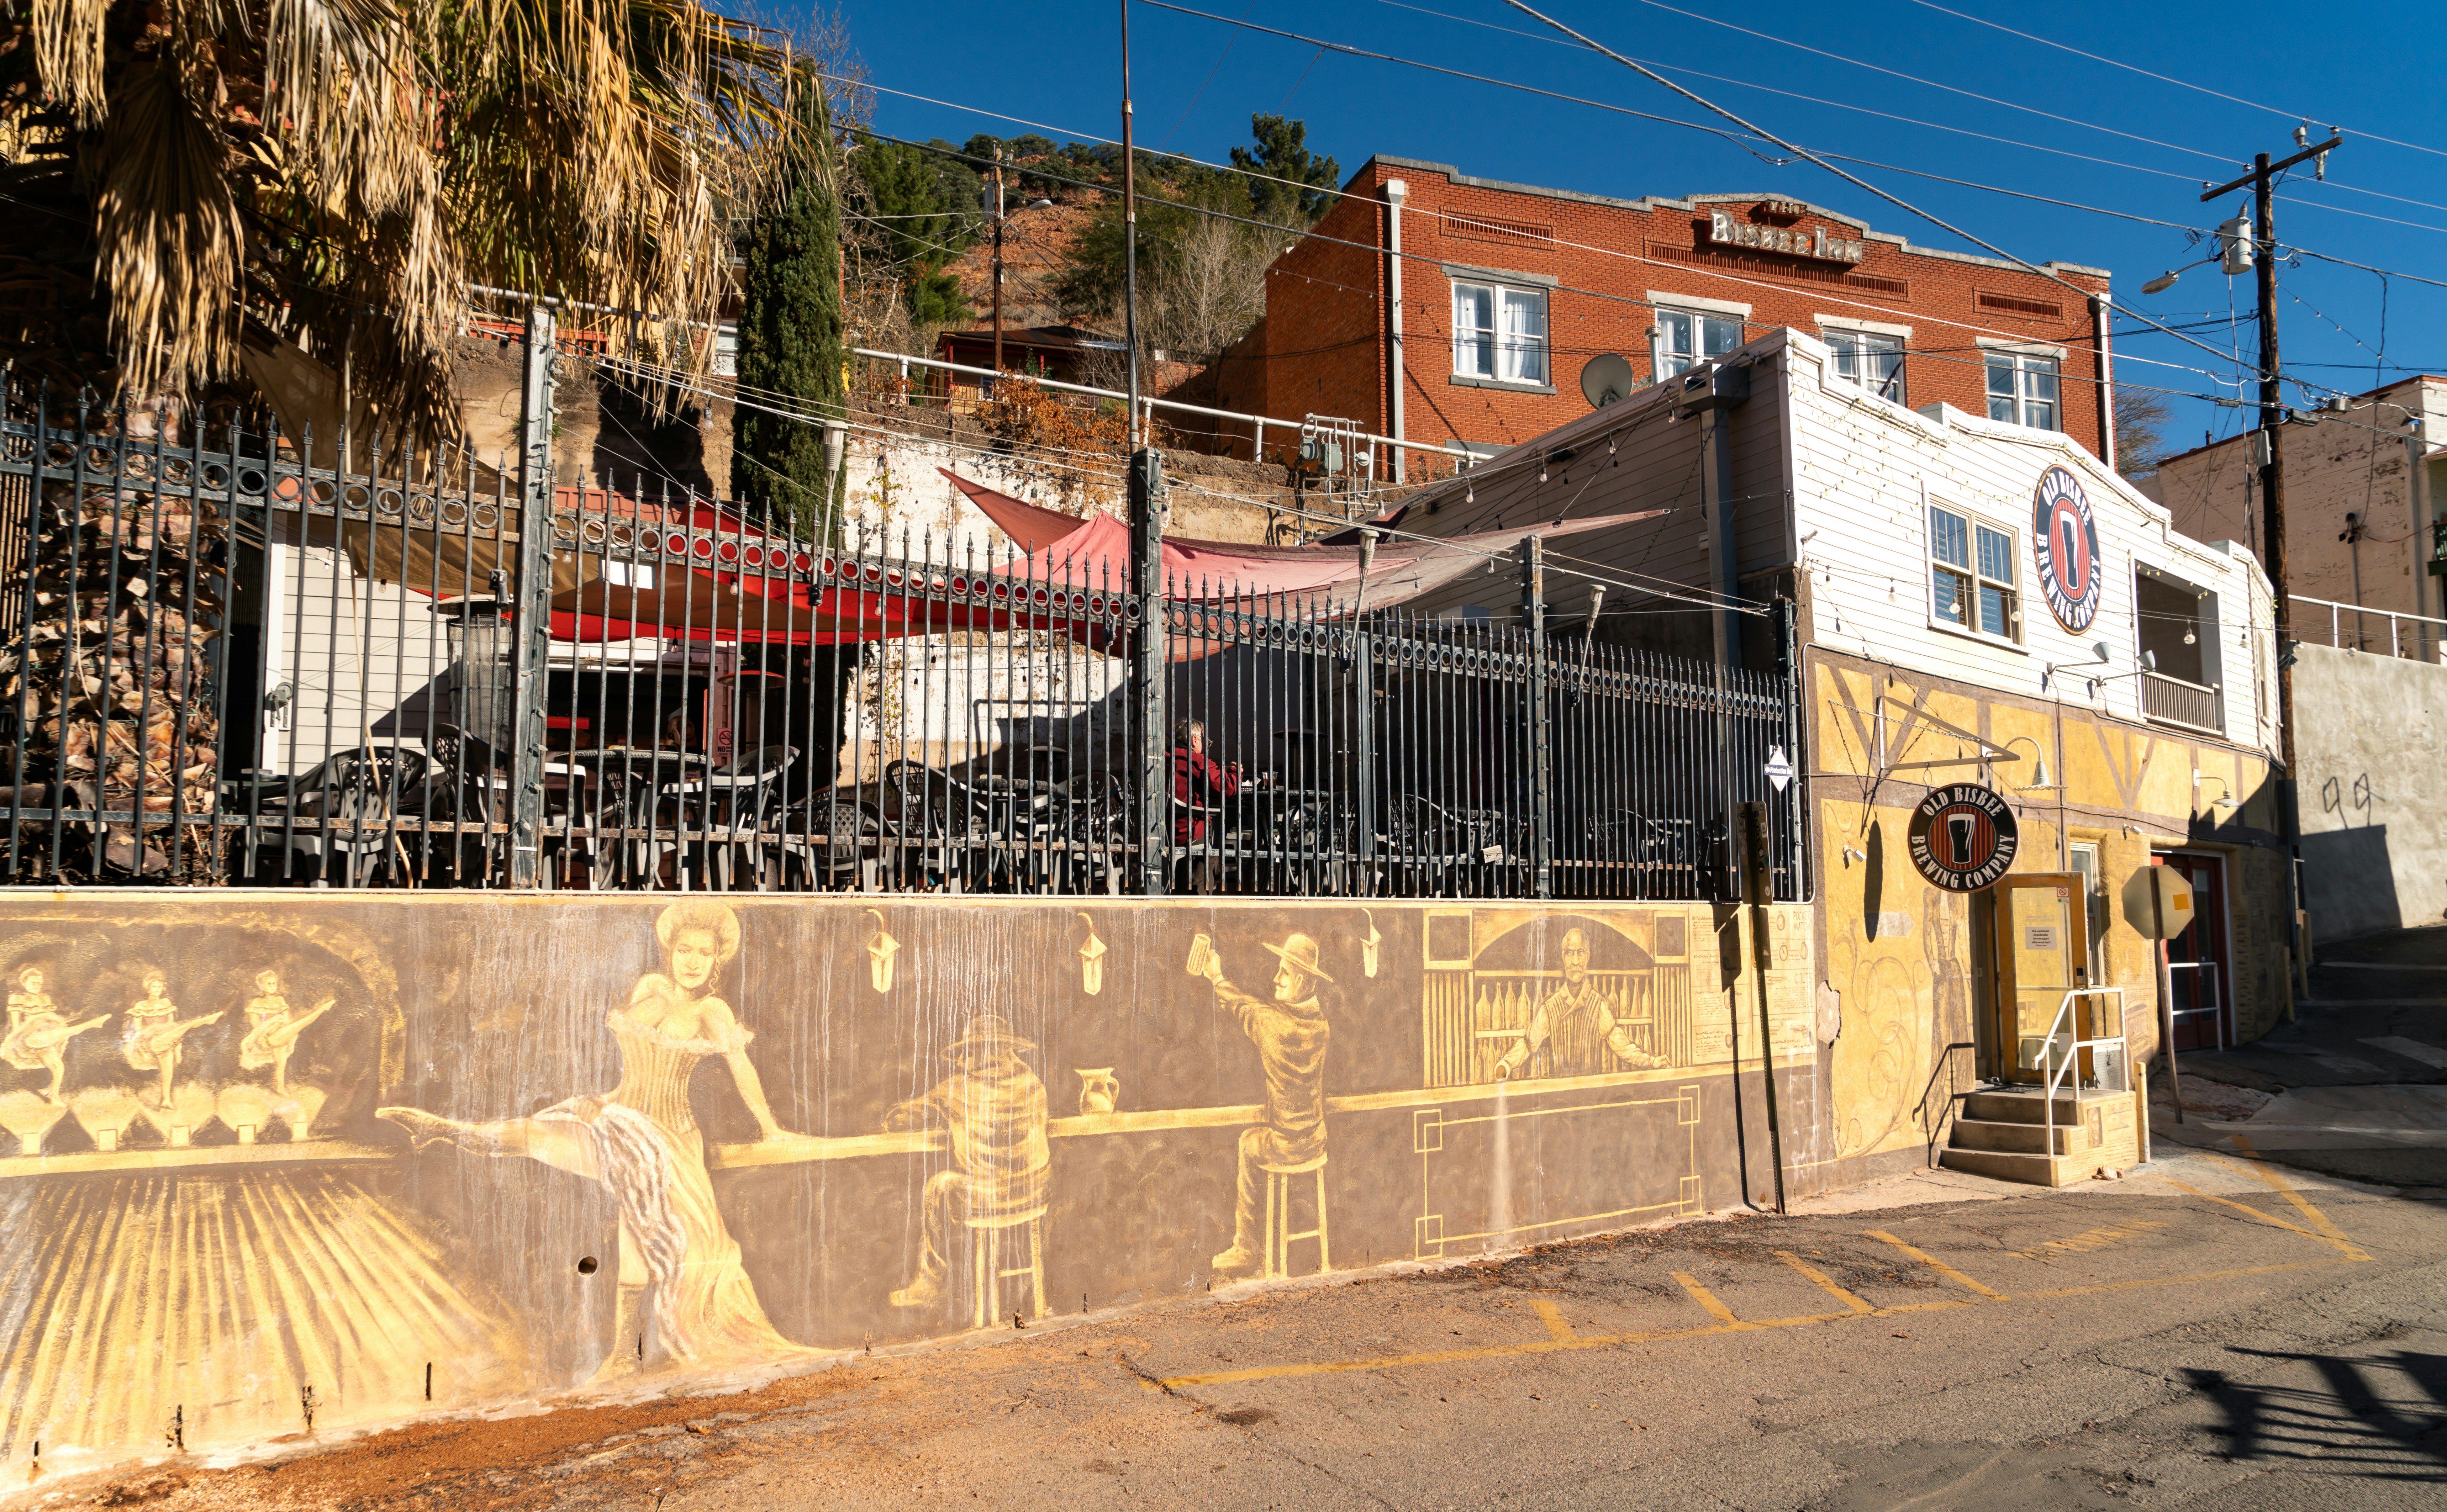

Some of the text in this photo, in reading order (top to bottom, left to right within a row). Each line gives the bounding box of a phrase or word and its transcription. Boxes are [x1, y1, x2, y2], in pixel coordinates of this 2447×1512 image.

[1766, 200, 1807, 215] THE
[1709, 208, 1863, 262] BISBEE INN
[2042, 471, 2091, 526] OLD BISBEE
[2036, 532, 2100, 629] BREWING COMPANY
[1923, 787, 2004, 816] OLD BISBEE
[1911, 835, 2015, 888] BREWING COMPANY
[1794, 973, 1812, 984] COLTS
